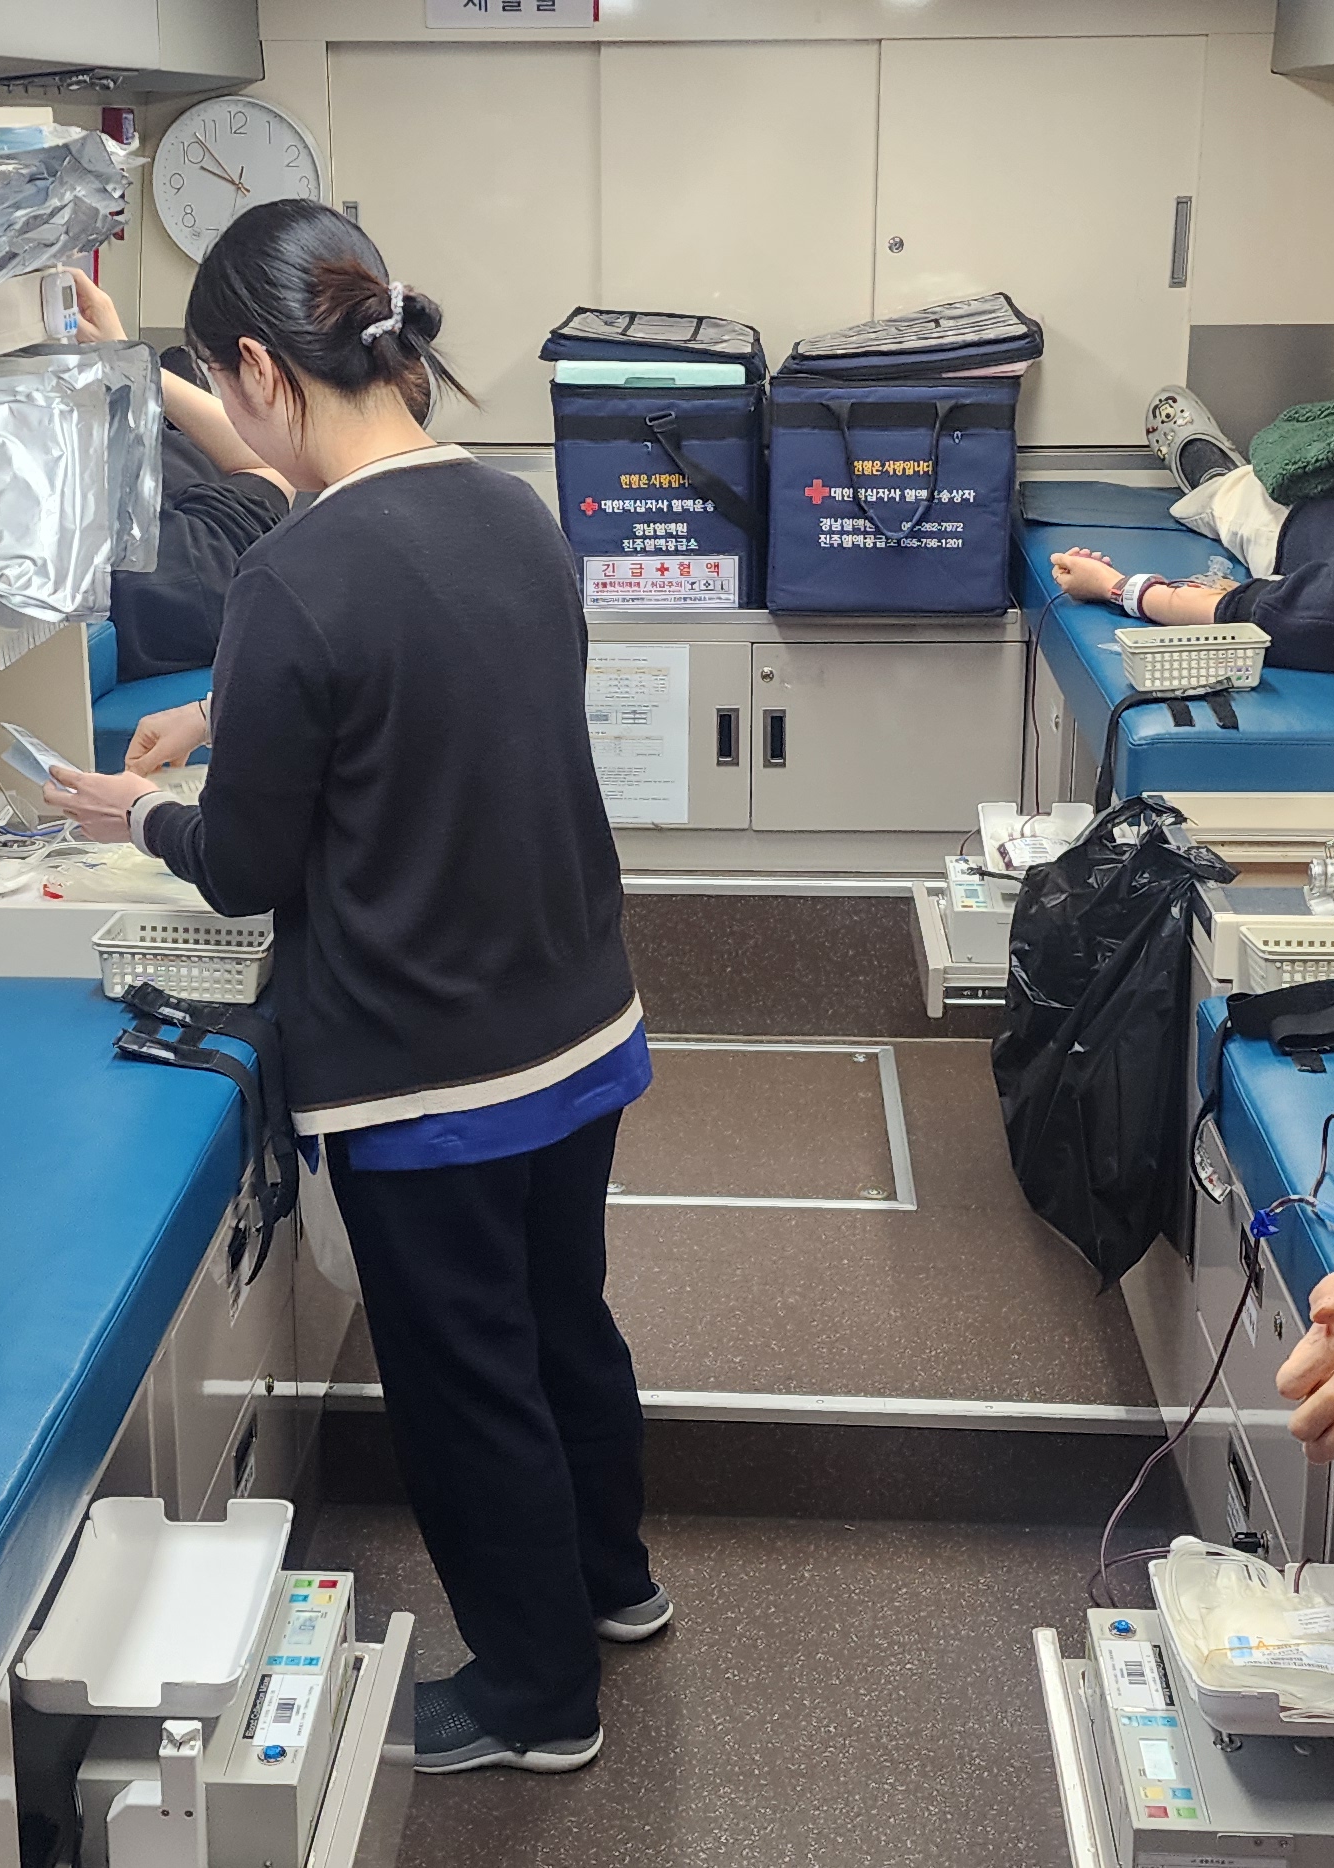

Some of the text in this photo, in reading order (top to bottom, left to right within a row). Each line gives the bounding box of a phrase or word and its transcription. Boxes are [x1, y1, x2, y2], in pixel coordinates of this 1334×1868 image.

[202, 119, 217, 143] 11
[227, 110, 248, 134] 12
[266, 120, 271, 144] 1
[181, 141, 205, 165] 10
[285, 144, 300, 167] 2
[169, 172, 185, 195] 9
[297, 175, 311, 199] 3
[182, 204, 196, 228] 8
[853, 460, 933, 475] 헌혈은 사랑입니다
[619, 473, 693, 489] 헌혈은 사랑입니
[600, 499, 669, 513] 대한적십자사
[830, 487, 901, 502] 대한적십자사
[632, 522, 688, 536] 경남혈액원
[818, 533, 963, 548] 진주혈액공급소 055-756-1201
[621, 537, 699, 551] 진주혈액공급소
